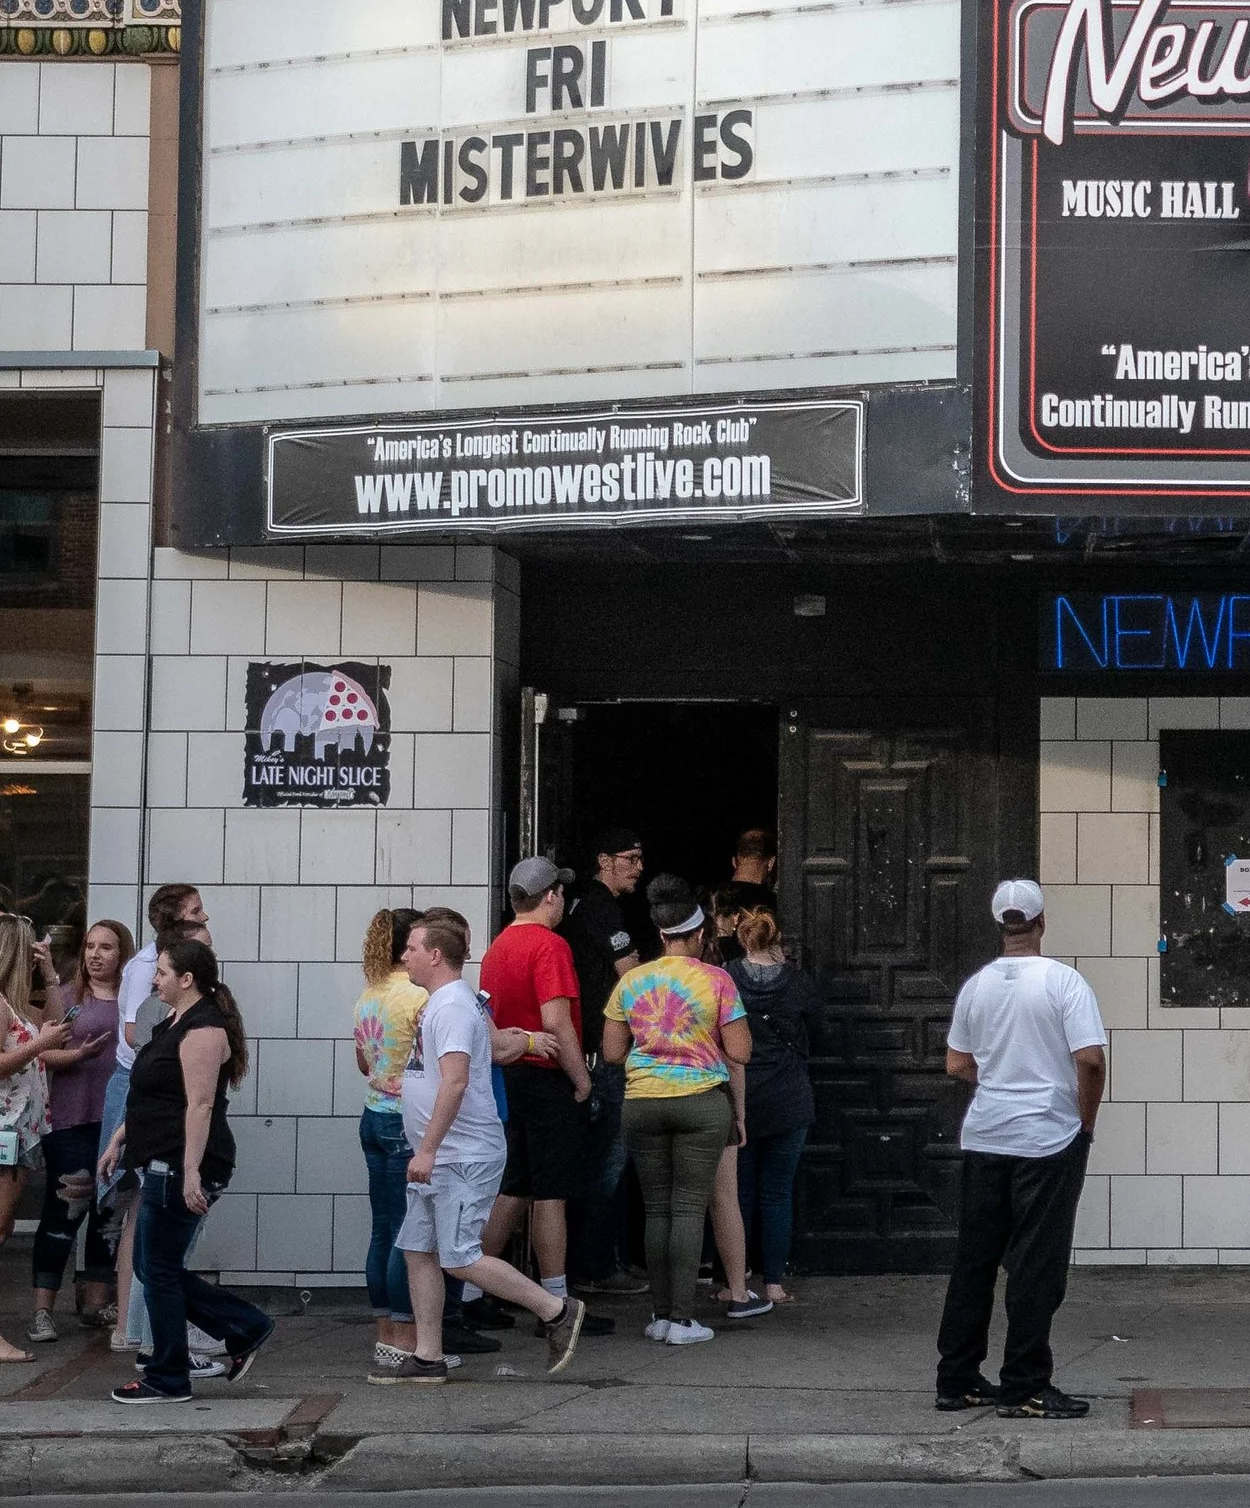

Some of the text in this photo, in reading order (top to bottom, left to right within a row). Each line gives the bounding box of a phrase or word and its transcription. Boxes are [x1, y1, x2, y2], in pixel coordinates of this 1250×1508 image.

[526, 40, 606, 114] FRI
[399, 110, 754, 206] MISTERWIVES
[1061, 180, 1152, 220] MUSIC
[1159, 182, 1240, 220] HALL
[1041, 393, 1197, 435] Continually
[455, 430, 520, 459] Longest
[522, 424, 607, 457] Continually
[609, 421, 670, 453] Running
[672, 421, 713, 448] Rock
[353, 452, 772, 516] www.promowestlive.com
[251, 765, 382, 787] LATE NIGHT SLICE
